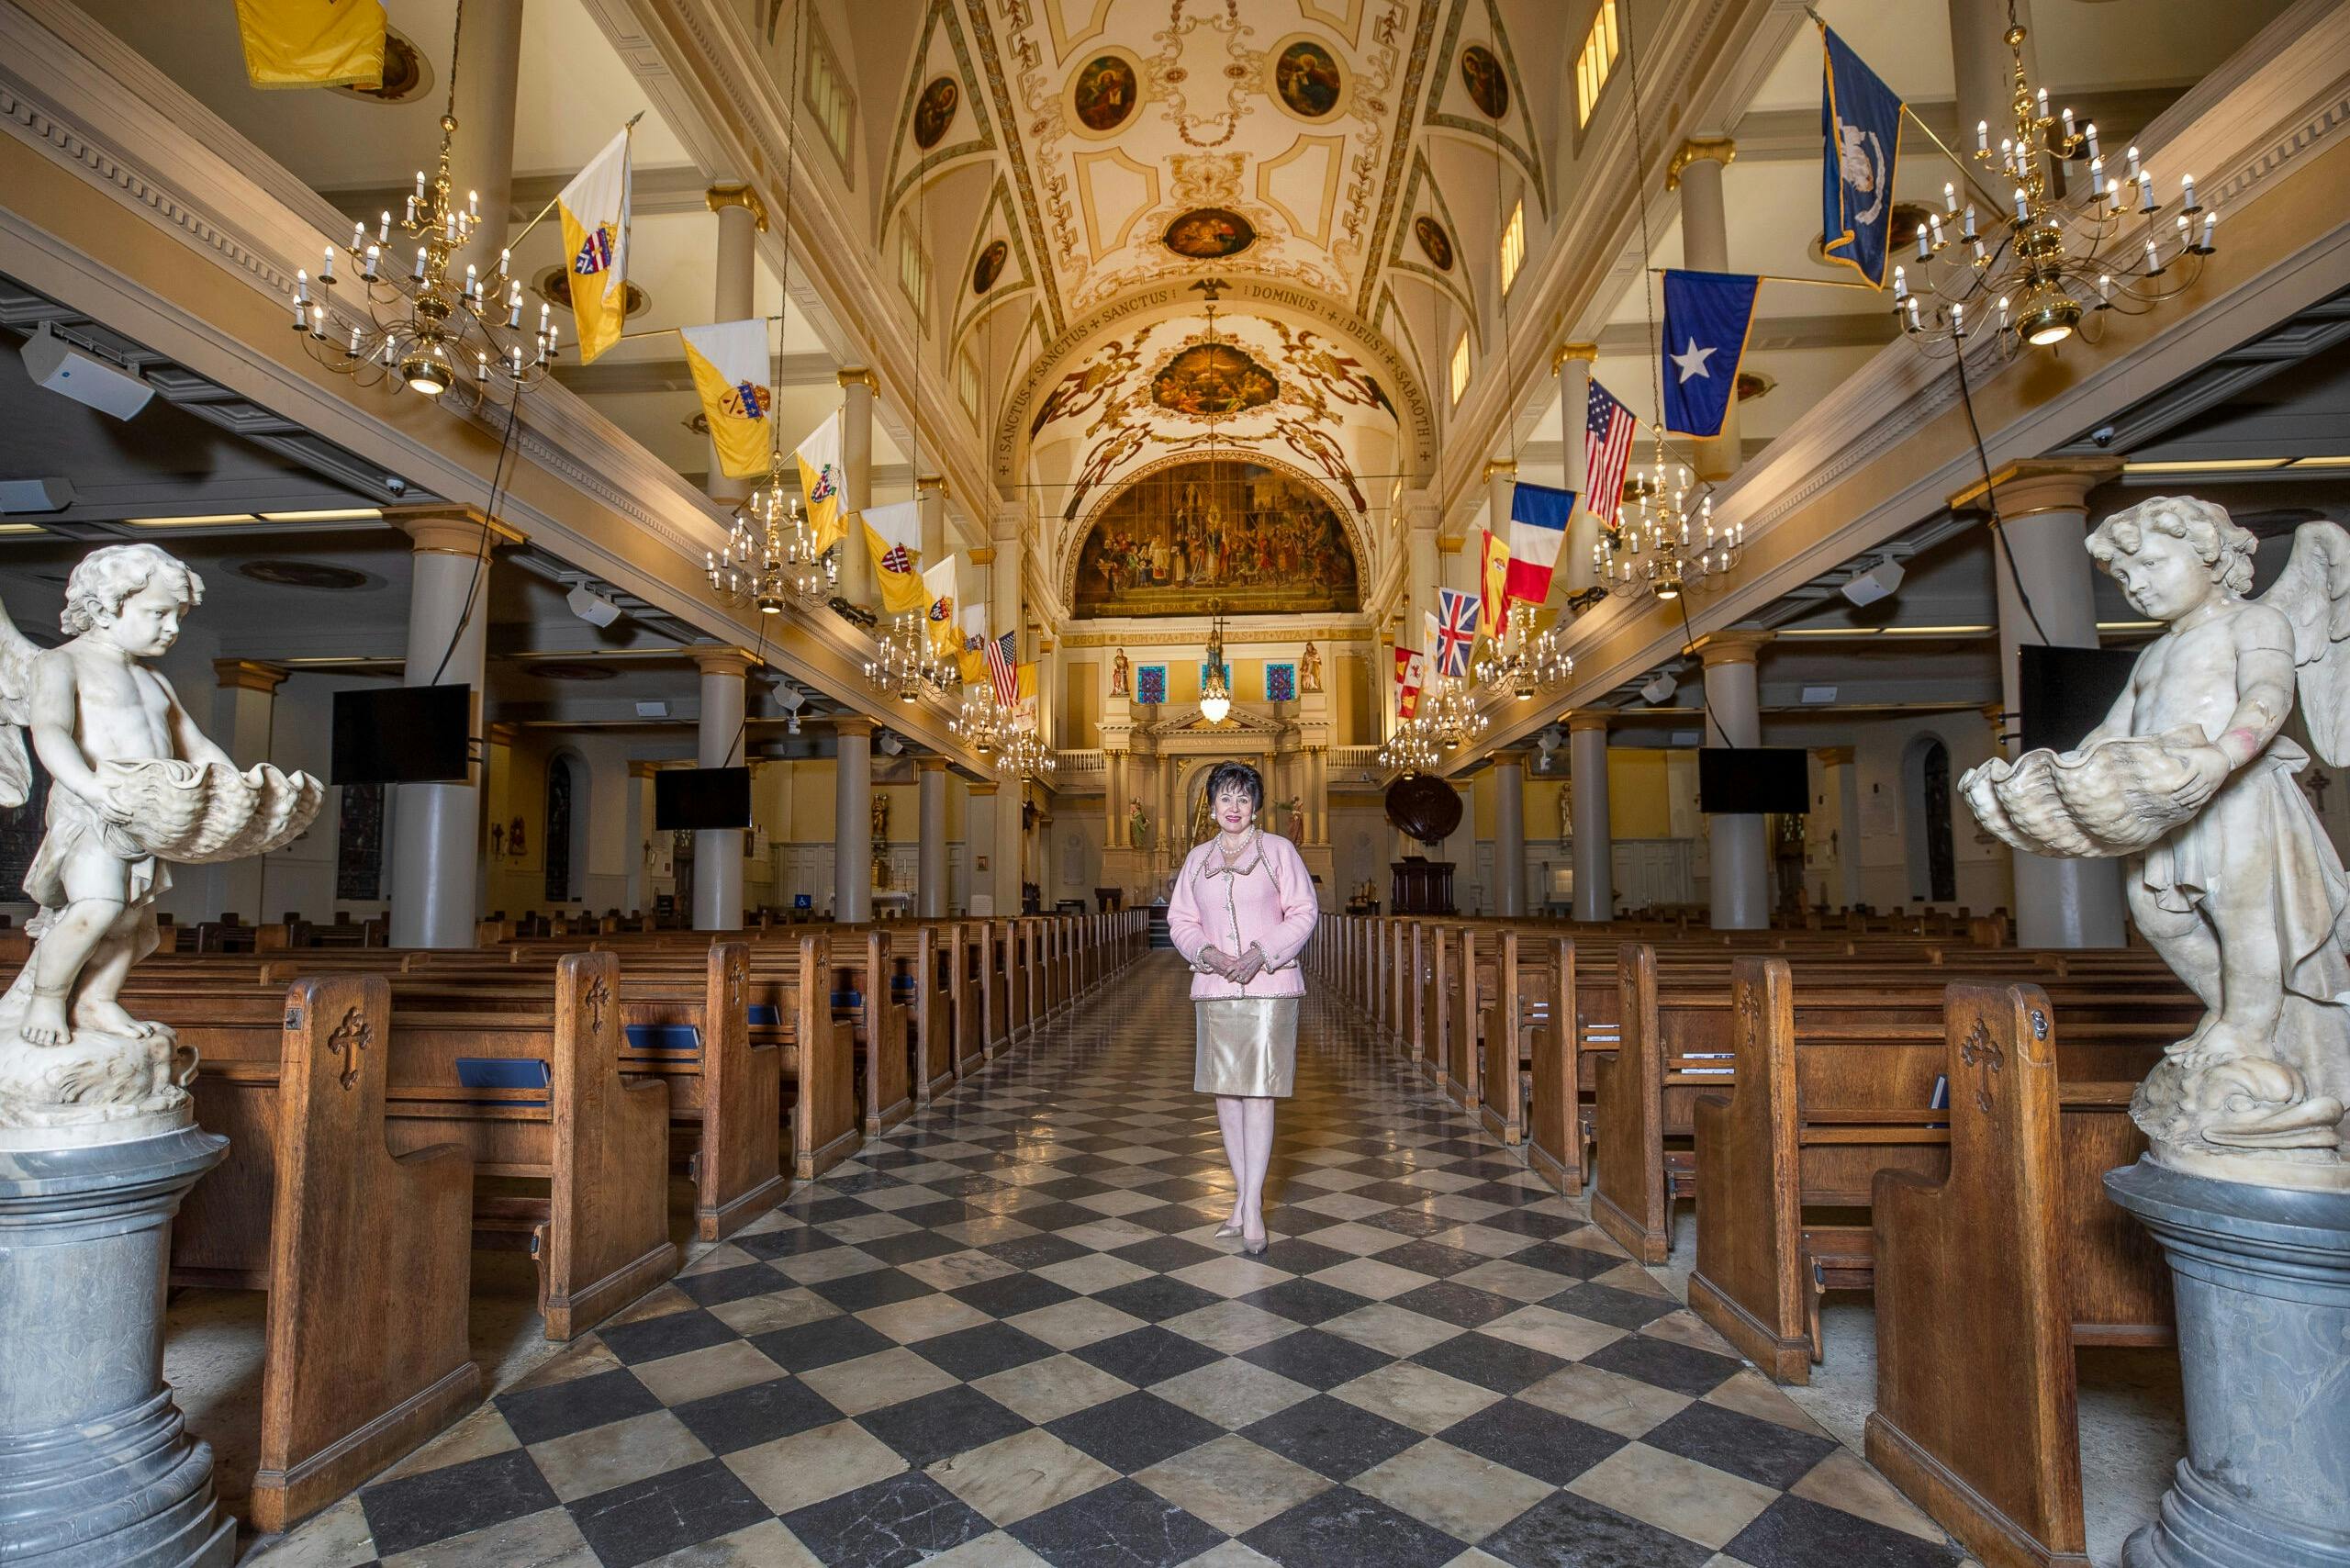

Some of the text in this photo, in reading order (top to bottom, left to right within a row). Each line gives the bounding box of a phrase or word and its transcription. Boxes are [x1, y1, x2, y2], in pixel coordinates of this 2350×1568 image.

[1000, 286, 1430, 453] SANCTUS SANCTUS SANCTUS DOMINUS DEUS SABAOTH
[1072, 634, 1095, 644] EGO
[1127, 633, 1149, 644] SUM
[1157, 633, 1176, 643] VIA
[1181, 632, 1195, 643] ET
[1252, 631, 1268, 641] ET
[1276, 629, 1304, 641] VITA
